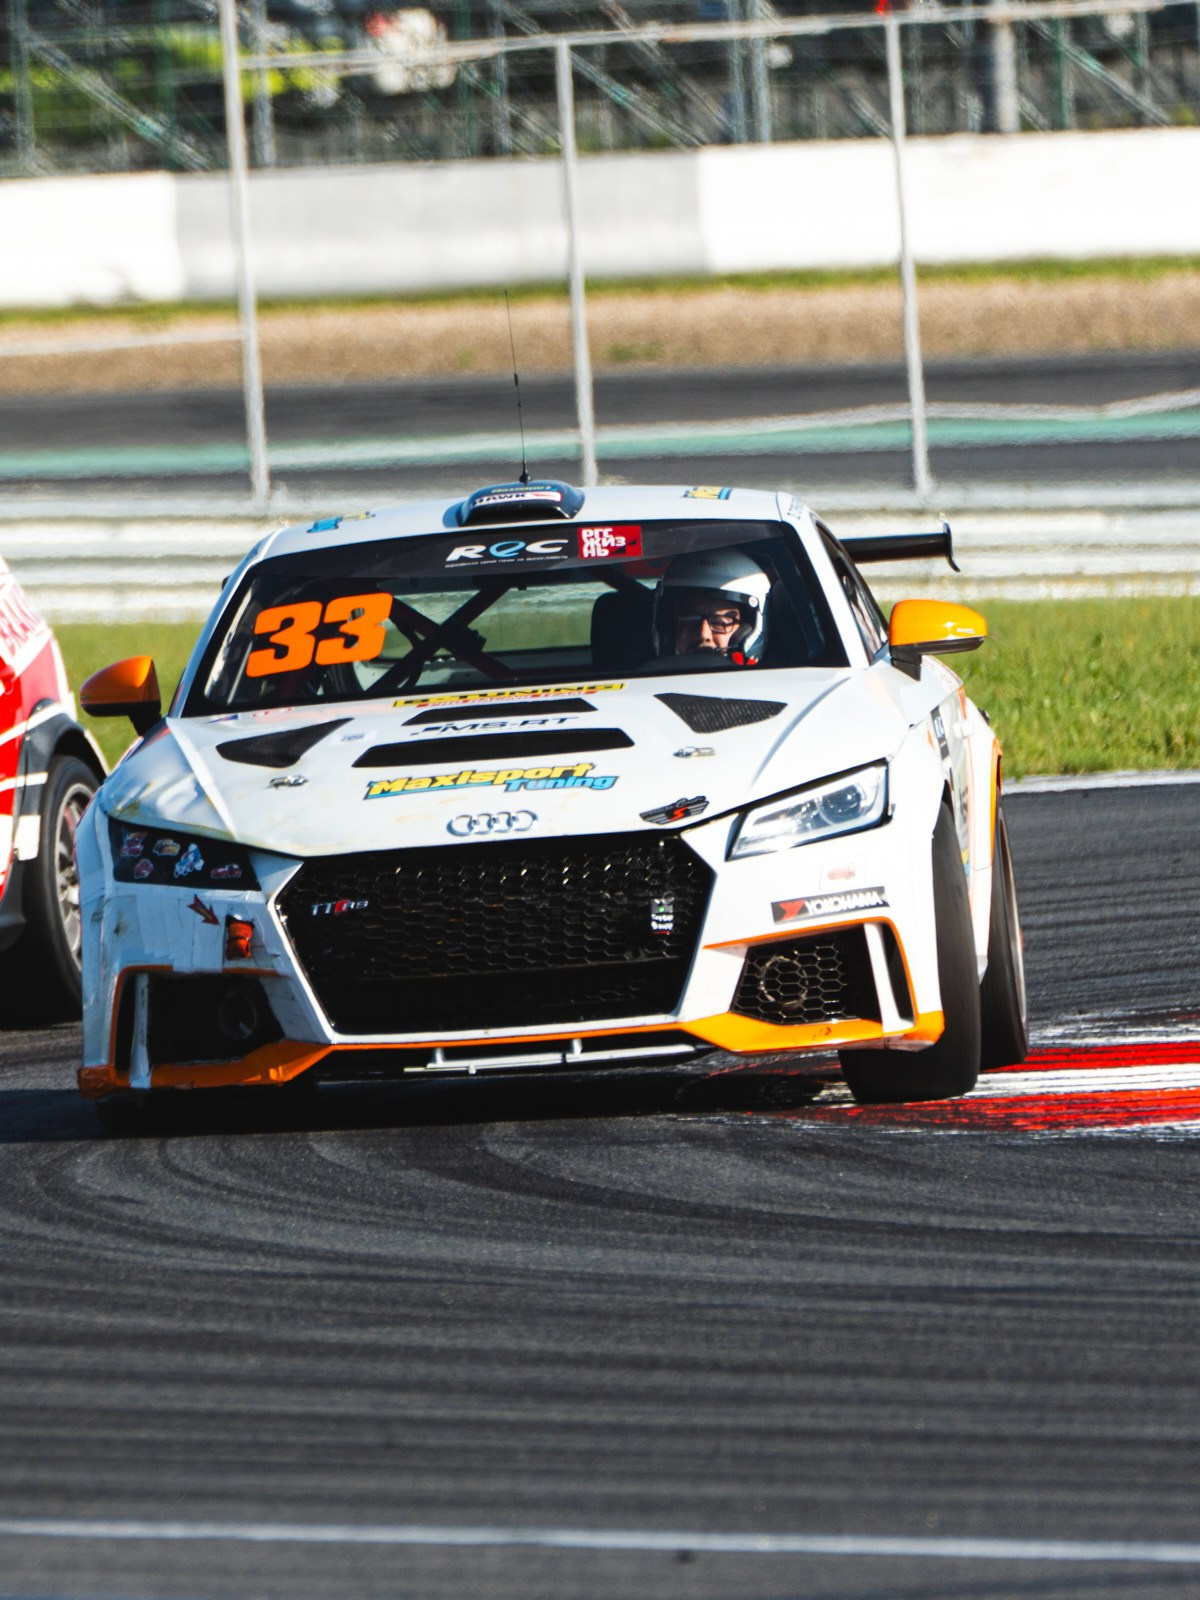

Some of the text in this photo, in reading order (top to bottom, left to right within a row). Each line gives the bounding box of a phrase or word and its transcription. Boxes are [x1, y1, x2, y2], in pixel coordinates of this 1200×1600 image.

[581, 527, 614, 539] РГС
[582, 537, 627, 548] ЖИЗ
[583, 546, 610, 558] НЬ
[246, 592, 393, 678] 33
[366, 762, 593, 798] Maxisport
[504, 774, 619, 793] Tuning
[804, 890, 884, 916] YOKOHAMA
